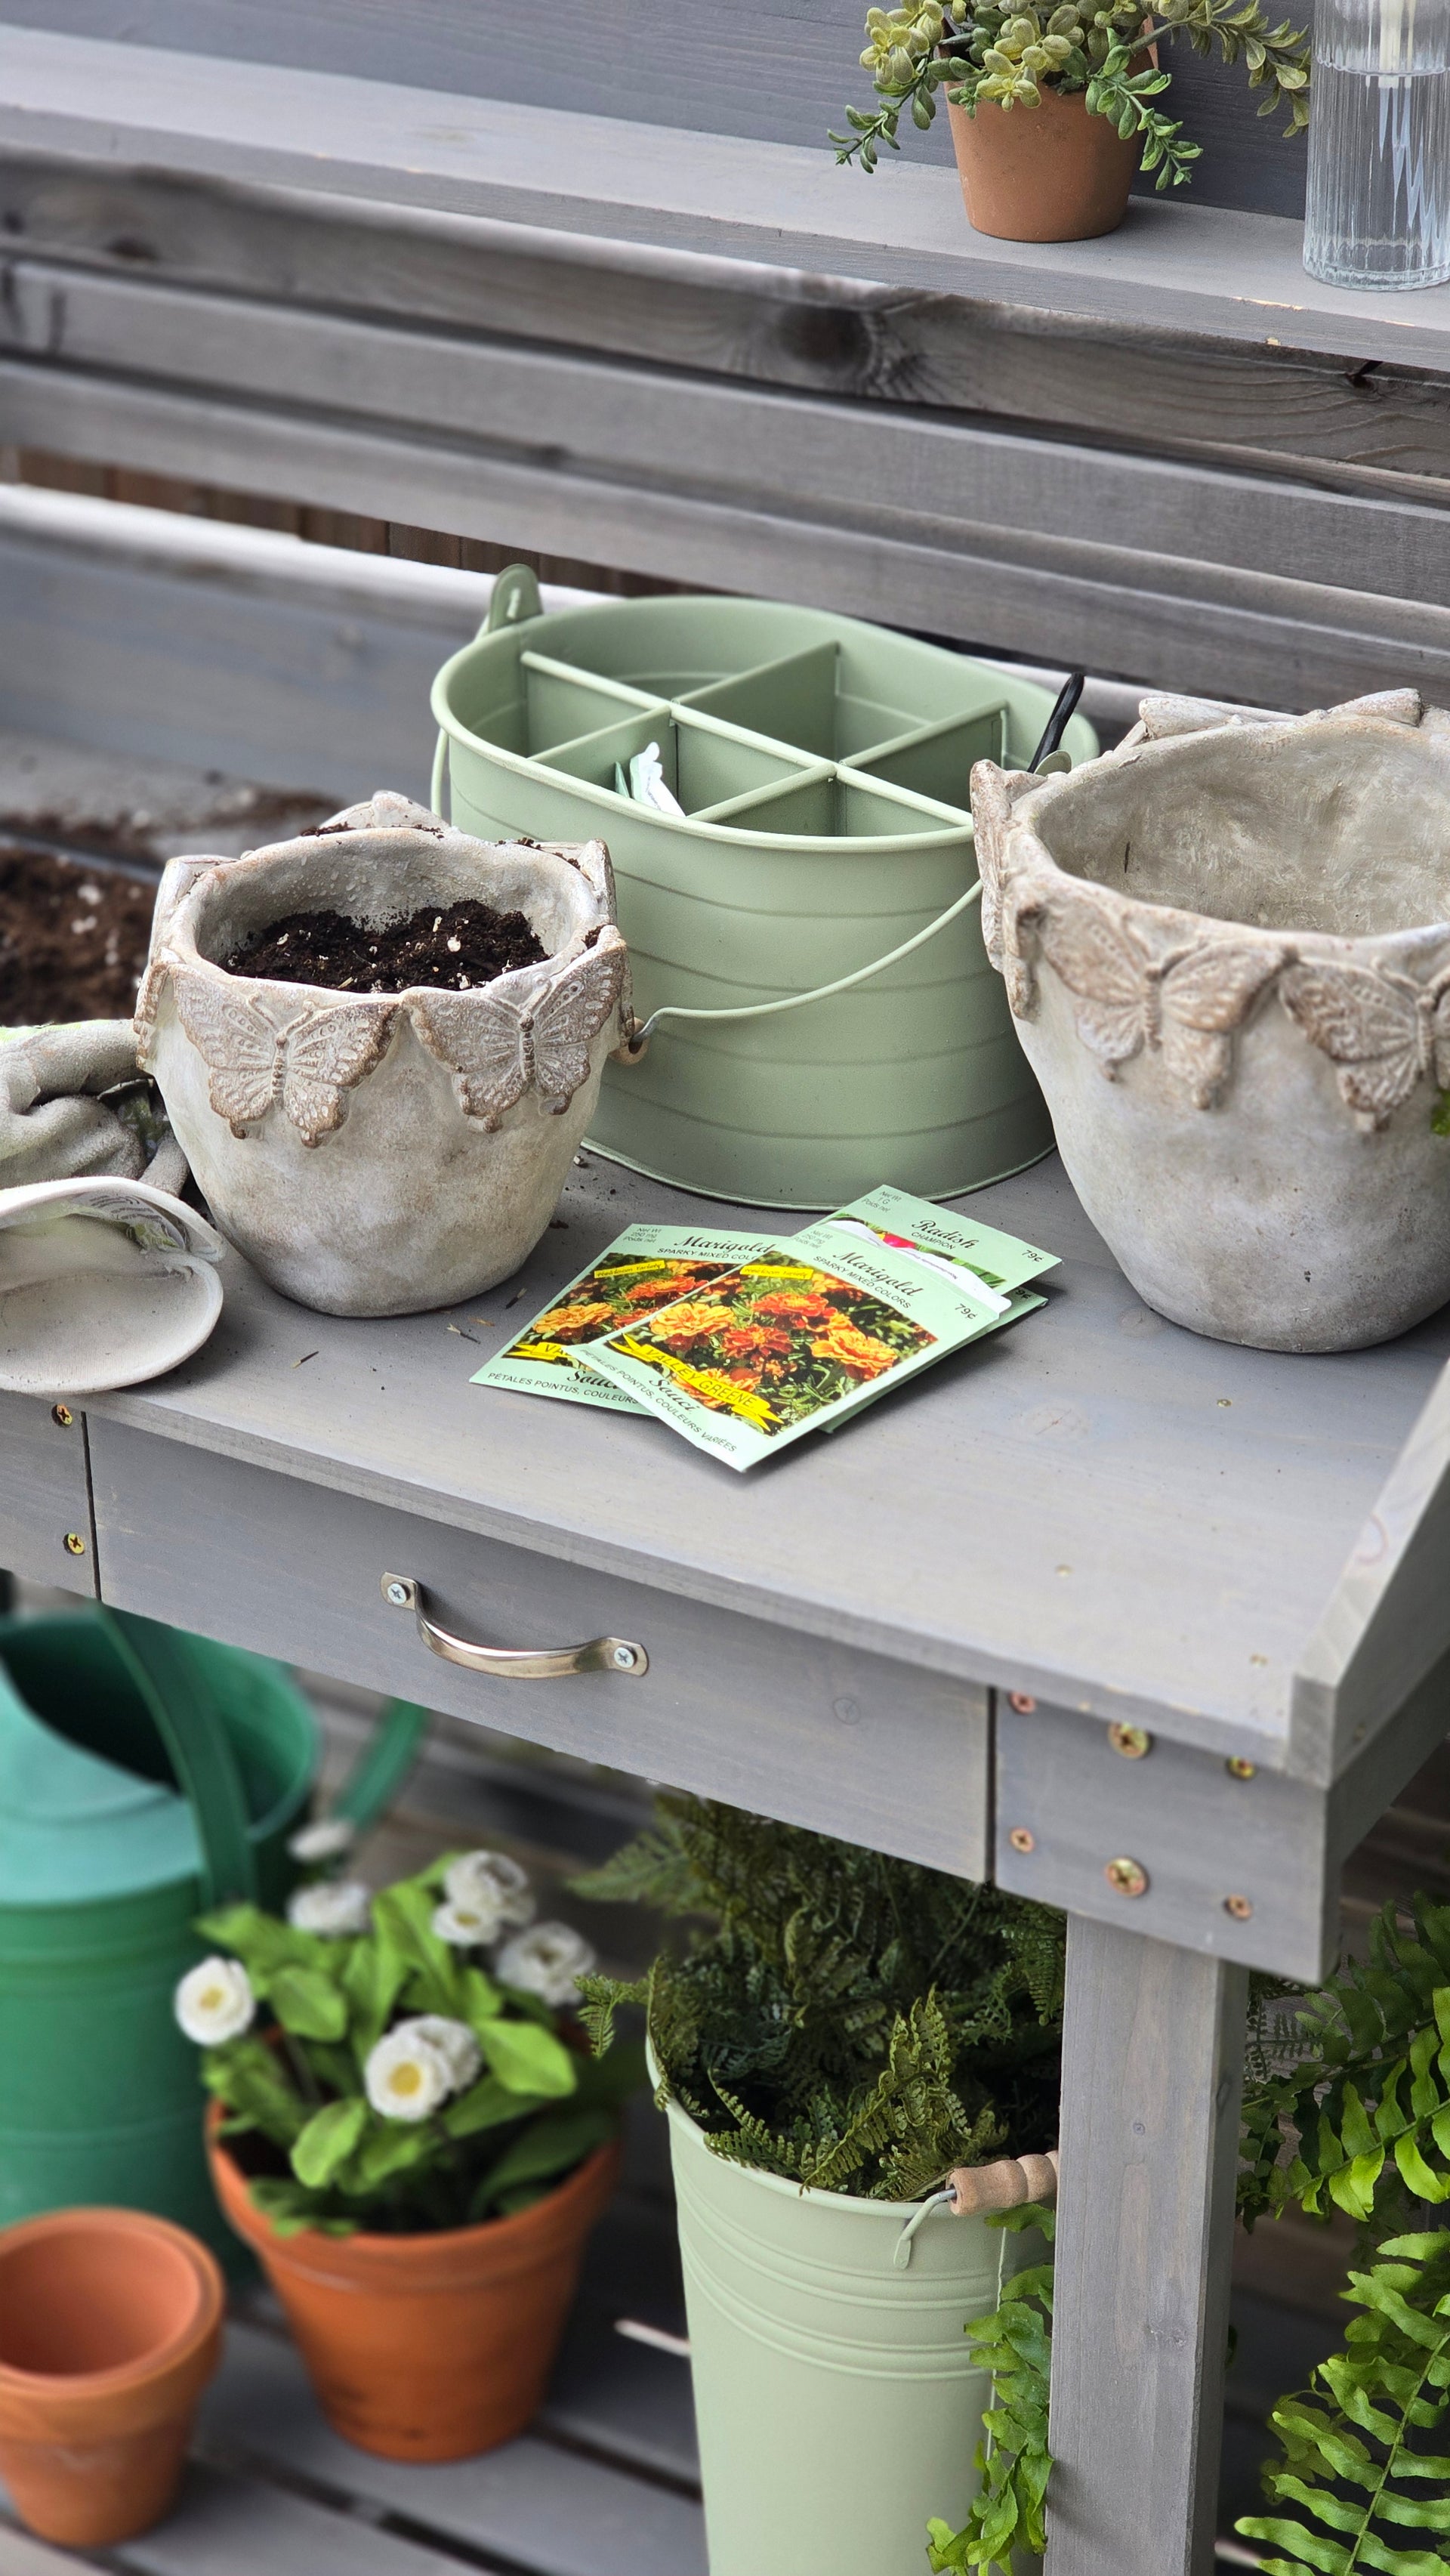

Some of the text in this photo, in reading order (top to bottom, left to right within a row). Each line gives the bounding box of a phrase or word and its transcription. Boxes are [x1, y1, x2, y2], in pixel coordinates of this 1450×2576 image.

[674, 1236, 776, 1253] Marigold
[911, 1231, 956, 1249] CHAMPION
[912, 1219, 980, 1249] Radish
[657, 1247, 697, 1256] SPARKY
[1022, 1249, 1043, 1262] 79¢
[813, 1256, 912, 1308] SPARKY MIXED COLORS
[832, 1252, 924, 1297] Marigold
[955, 1303, 978, 1320] 79¢
[488, 1372, 532, 1385] PÉTALES
[534, 1380, 580, 1395] POINTUS,
[646, 1348, 757, 1407] VALLEY GREENE
[618, 1370, 654, 1400] POINTUS,
[655, 1397, 702, 1433] COULEURS
[701, 1432, 737, 1452] VARIÉES
